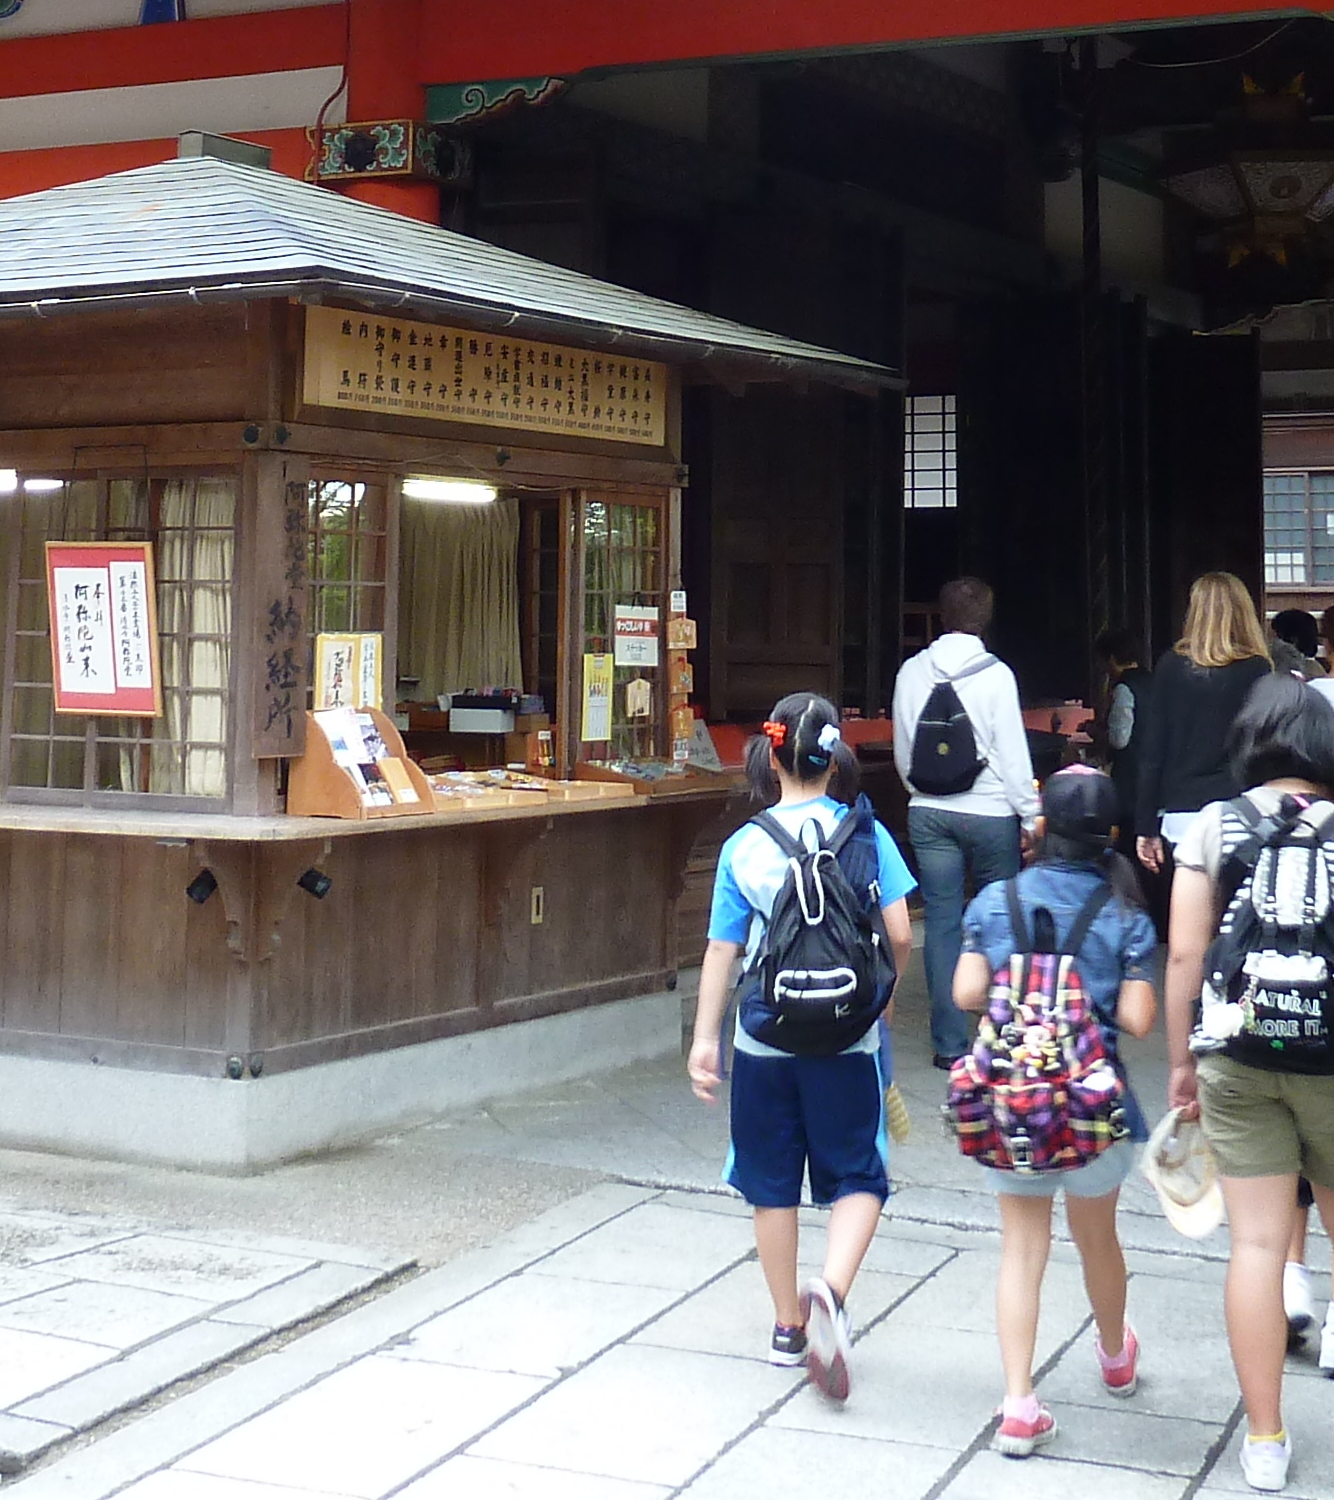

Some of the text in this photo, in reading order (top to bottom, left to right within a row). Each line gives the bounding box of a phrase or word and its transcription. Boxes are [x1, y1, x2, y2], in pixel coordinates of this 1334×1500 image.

[264, 595, 302, 739] 納経所
[1253, 988, 1322, 1016] ATURAL
